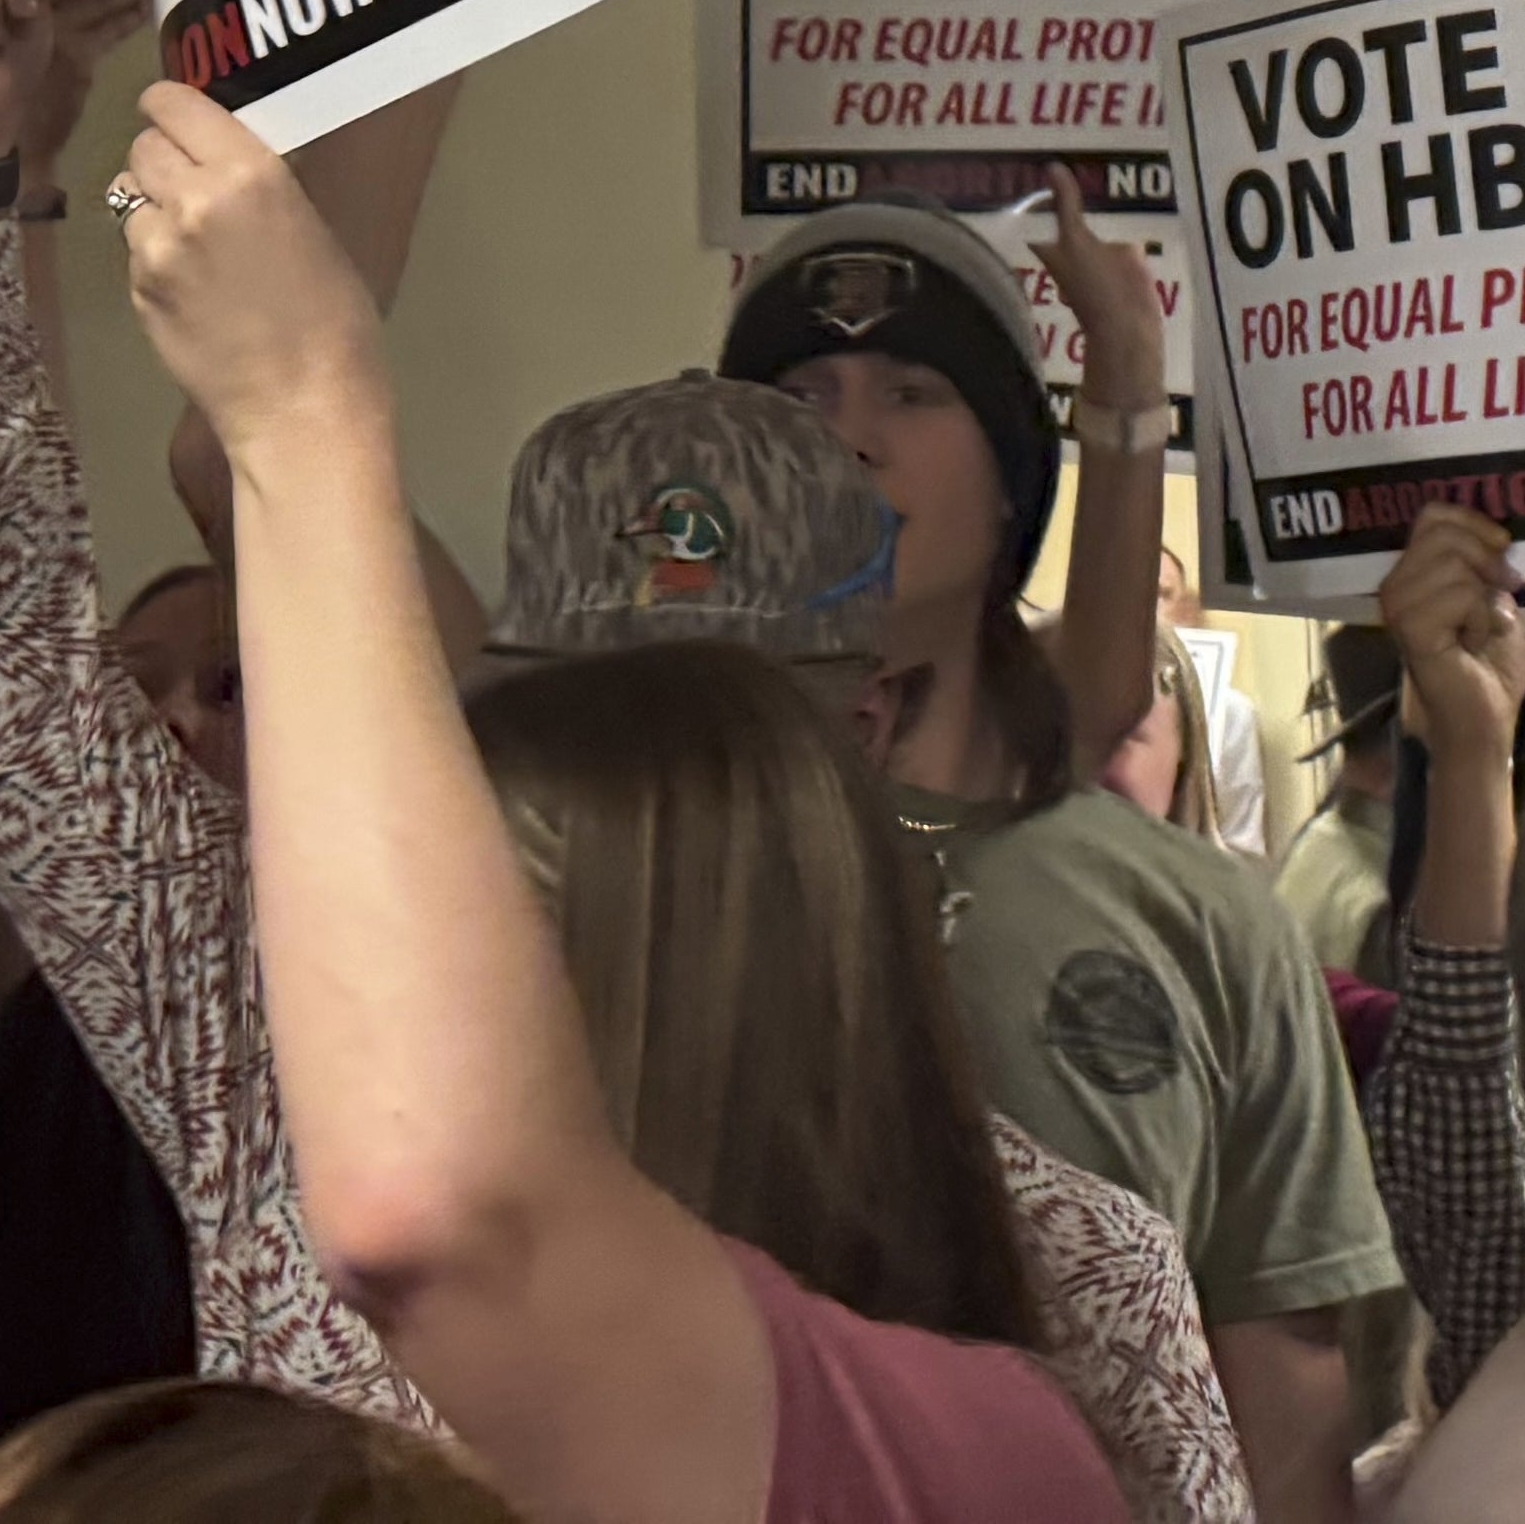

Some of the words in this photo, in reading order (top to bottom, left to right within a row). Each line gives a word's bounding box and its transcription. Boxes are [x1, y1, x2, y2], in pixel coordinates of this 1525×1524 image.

[769, 17, 863, 64] FOR
[875, 16, 1023, 68] EQUAL
[1229, 8, 1507, 154] VOTE
[834, 82, 926, 127] FOR
[935, 82, 1019, 127] ALL
[1031, 82, 1127, 127] LIFE
[1223, 151, 1355, 271] ON
[1240, 293, 1312, 365] FOR
[1319, 273, 1465, 355] EQUAL
[1301, 373, 1373, 441] FOR
[1384, 355, 1468, 430] ALL
